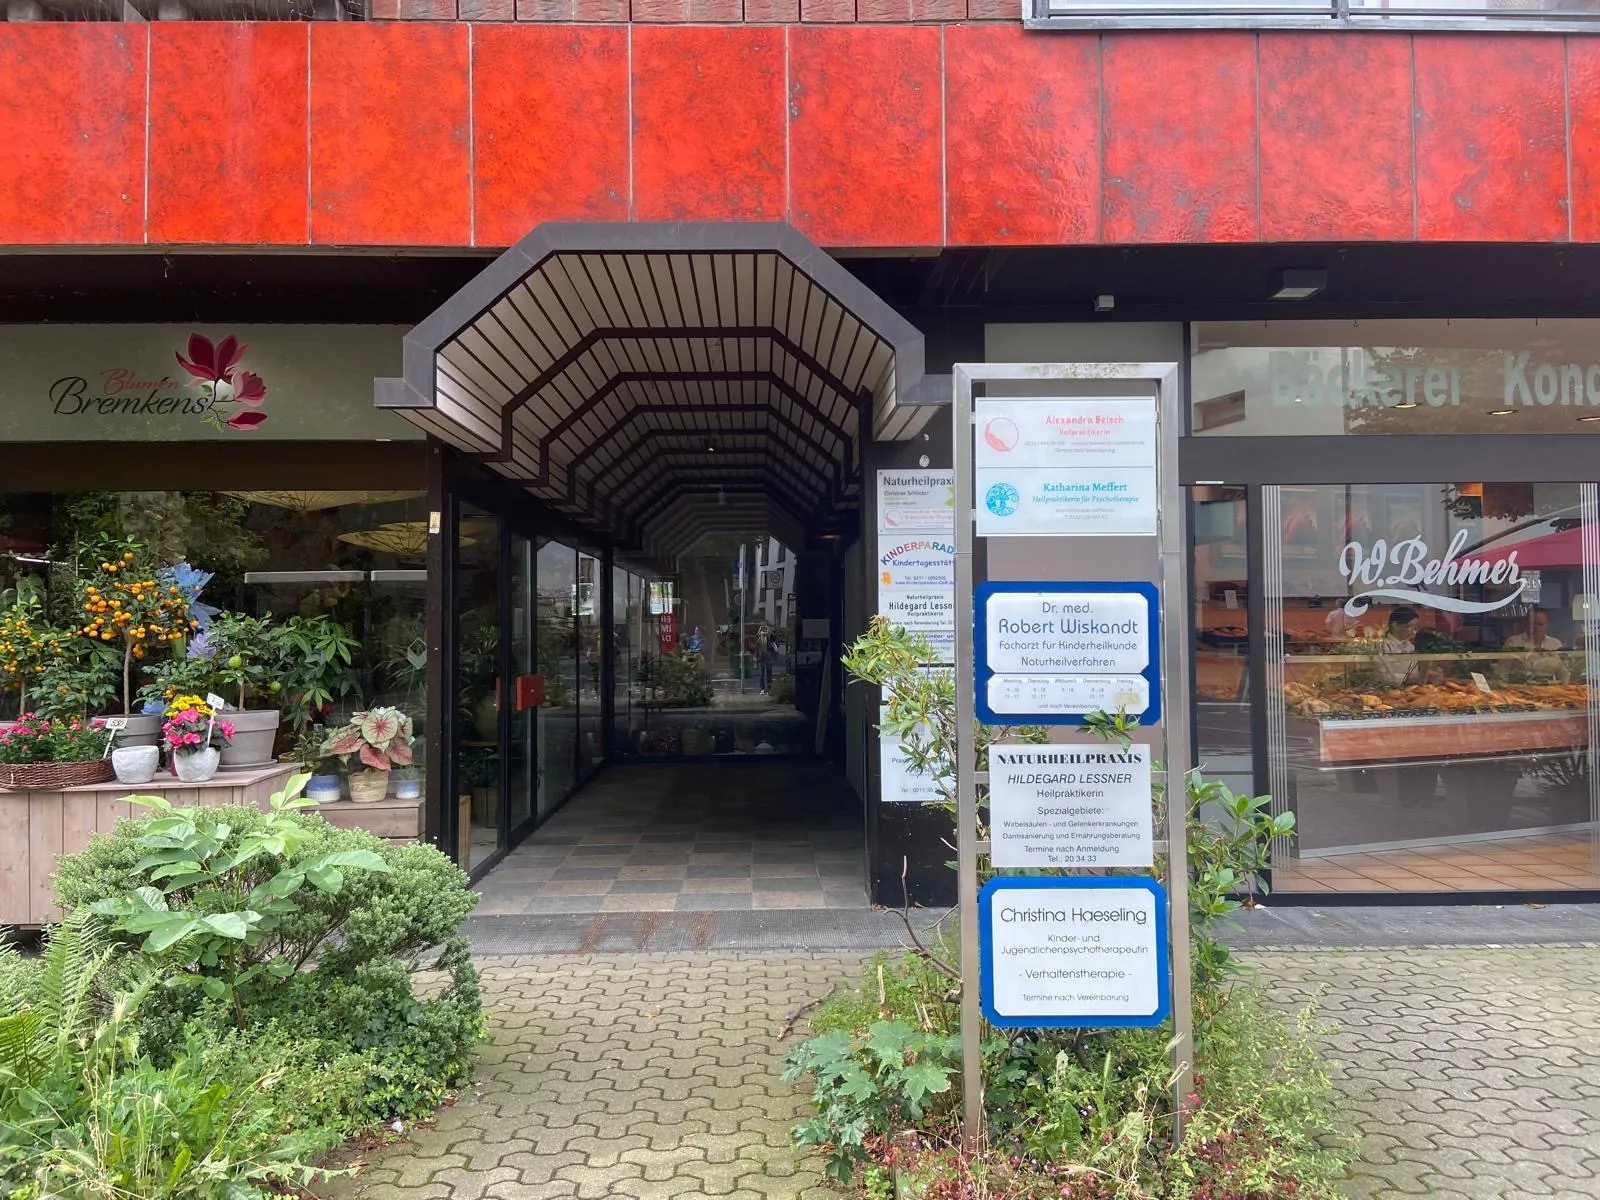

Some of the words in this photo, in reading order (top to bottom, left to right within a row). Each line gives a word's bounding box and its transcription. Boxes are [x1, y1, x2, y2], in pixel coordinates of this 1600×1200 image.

[49, 376, 208, 415] Bremkens
[1045, 415, 1093, 425] Alexandra
[883, 476, 954, 488] Naturheilpraxi
[1043, 483, 1090, 492] Katharina
[1092, 482, 1128, 492] Meffert
[881, 541, 955, 566] KINDERPARAD
[892, 559, 954, 568] Kindertagesstät
[889, 602, 927, 611] Hildegard
[930, 602, 954, 610] Lessn
[1042, 602, 1059, 614] Dr.
[1062, 602, 1094, 614] med.
[998, 618, 1055, 634] Robert
[1060, 618, 1139, 634] Wiskandt
[999, 640, 1039, 650] Facharzt
[1058, 640, 1138, 650] Kinderheilkunde
[1021, 656, 1116, 667] Naturheilverfahren
[998, 753, 1142, 765] NATURHEILPRAXIS
[1007, 773, 1076, 784] HILDEGARD
[1079, 773, 1132, 784] LESSNER
[1036, 789, 1104, 798] Heilpraktikerin
[1037, 806, 1104, 816] Spezialgebiete:
[1003, 820, 1047, 828] Wirbelsäulen
[1053, 820, 1067, 828] und
[1067, 820, 1139, 829] Gelenkerkrankungen
[1002, 832, 1055, 841] Darmsanierung
[1056, 832, 1069, 840] und
[1070, 831, 1141, 840] Ernährungsberatung
[1024, 845, 1054, 853] Termine
[1055, 845, 1075, 853] nach
[1076, 845, 1120, 853] Anmeldung
[1000, 908, 1066, 923] Christina
[1072, 908, 1147, 925] Haeseling
[1047, 934, 1080, 943] Kinder-
[1082, 934, 1100, 942] und
[1001, 945, 1149, 955] Jugendlichenpsychotherapeutin
[1024, 969, 1125, 980] Verhaltenstherapie
[1023, 994, 1053, 1002] Termine
[1054, 994, 1075, 1002] nach
[1077, 994, 1130, 1003] Vereinbarung
